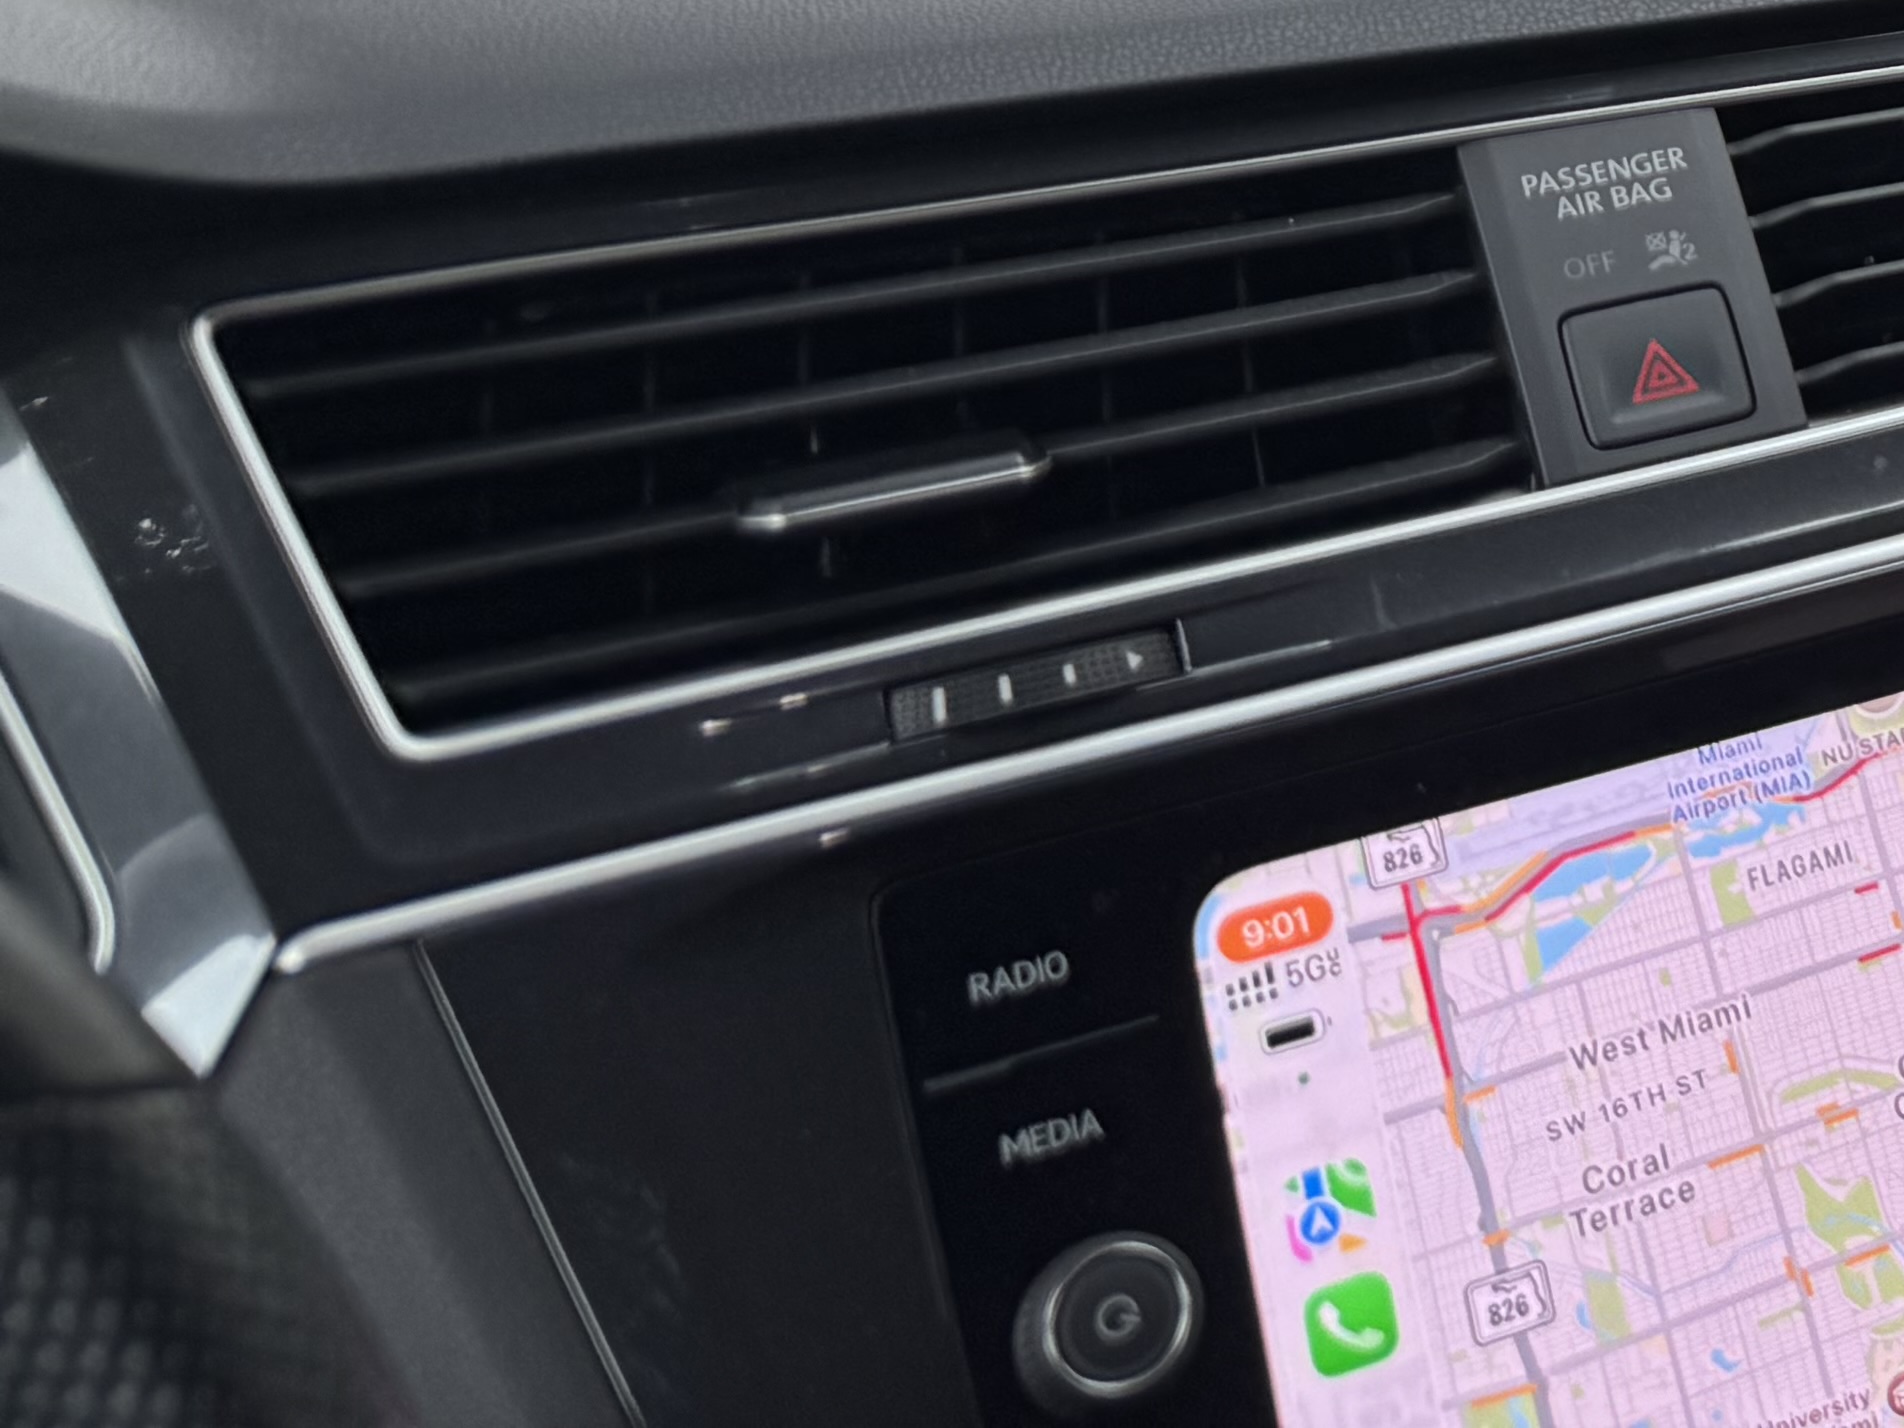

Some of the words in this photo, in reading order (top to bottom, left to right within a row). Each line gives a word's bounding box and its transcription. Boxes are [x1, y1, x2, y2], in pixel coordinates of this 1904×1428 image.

[1520, 146, 1689, 197] PASSENGER
[1557, 189, 1604, 220] AIR
[1611, 177, 1673, 211] BAG
[1563, 250, 1617, 279] OFF
[1667, 746, 1804, 800] International
[1698, 734, 1763, 766] Miami
[1822, 745, 1854, 766] NU
[1672, 787, 1756, 823] Airport
[1755, 770, 1812, 804] (MIA)
[1383, 844, 1424, 873] 826
[1747, 840, 1854, 891] FLAGAMI
[1241, 906, 1311, 949] 9:01
[967, 949, 1070, 1007] RADIO
[1569, 1027, 1650, 1071] West
[1657, 993, 1751, 1045] Miami
[1545, 1110, 1586, 1142] SW
[1599, 1083, 1667, 1123] 16TH
[1675, 1068, 1706, 1096] ST
[999, 1108, 1106, 1168] MEDIA
[1581, 1142, 1669, 1195] Coral
[1569, 1180, 1696, 1237] Terrace
[1488, 1293, 1530, 1327] 826
